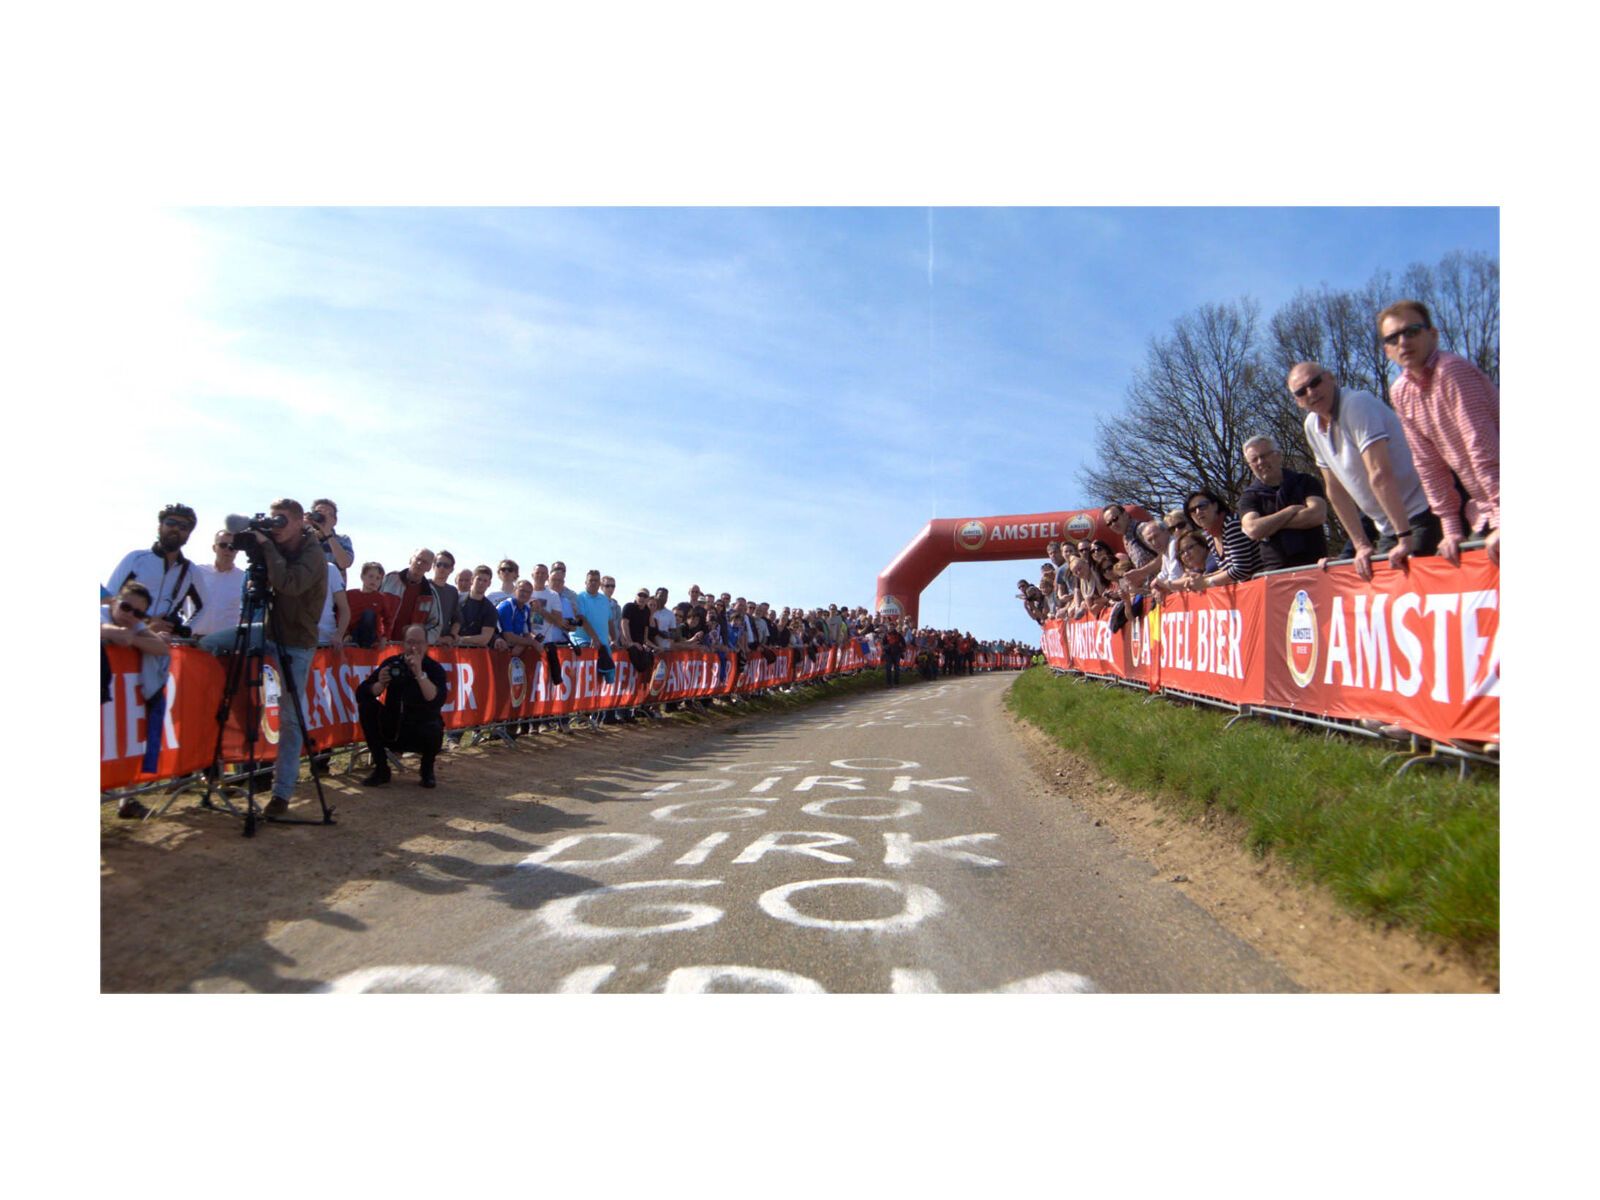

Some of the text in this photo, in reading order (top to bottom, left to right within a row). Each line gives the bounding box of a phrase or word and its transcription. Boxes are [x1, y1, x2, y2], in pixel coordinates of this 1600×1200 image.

[990, 522, 1059, 541] AMSTEL
[1141, 611, 1193, 671] ASTEL
[1197, 609, 1244, 679] BIER
[719, 757, 921, 774] GO
[640, 775, 972, 798] DIRK
[650, 796, 923, 821] GO
[516, 832, 1002, 869] DIRK
[535, 877, 946, 937] GO
